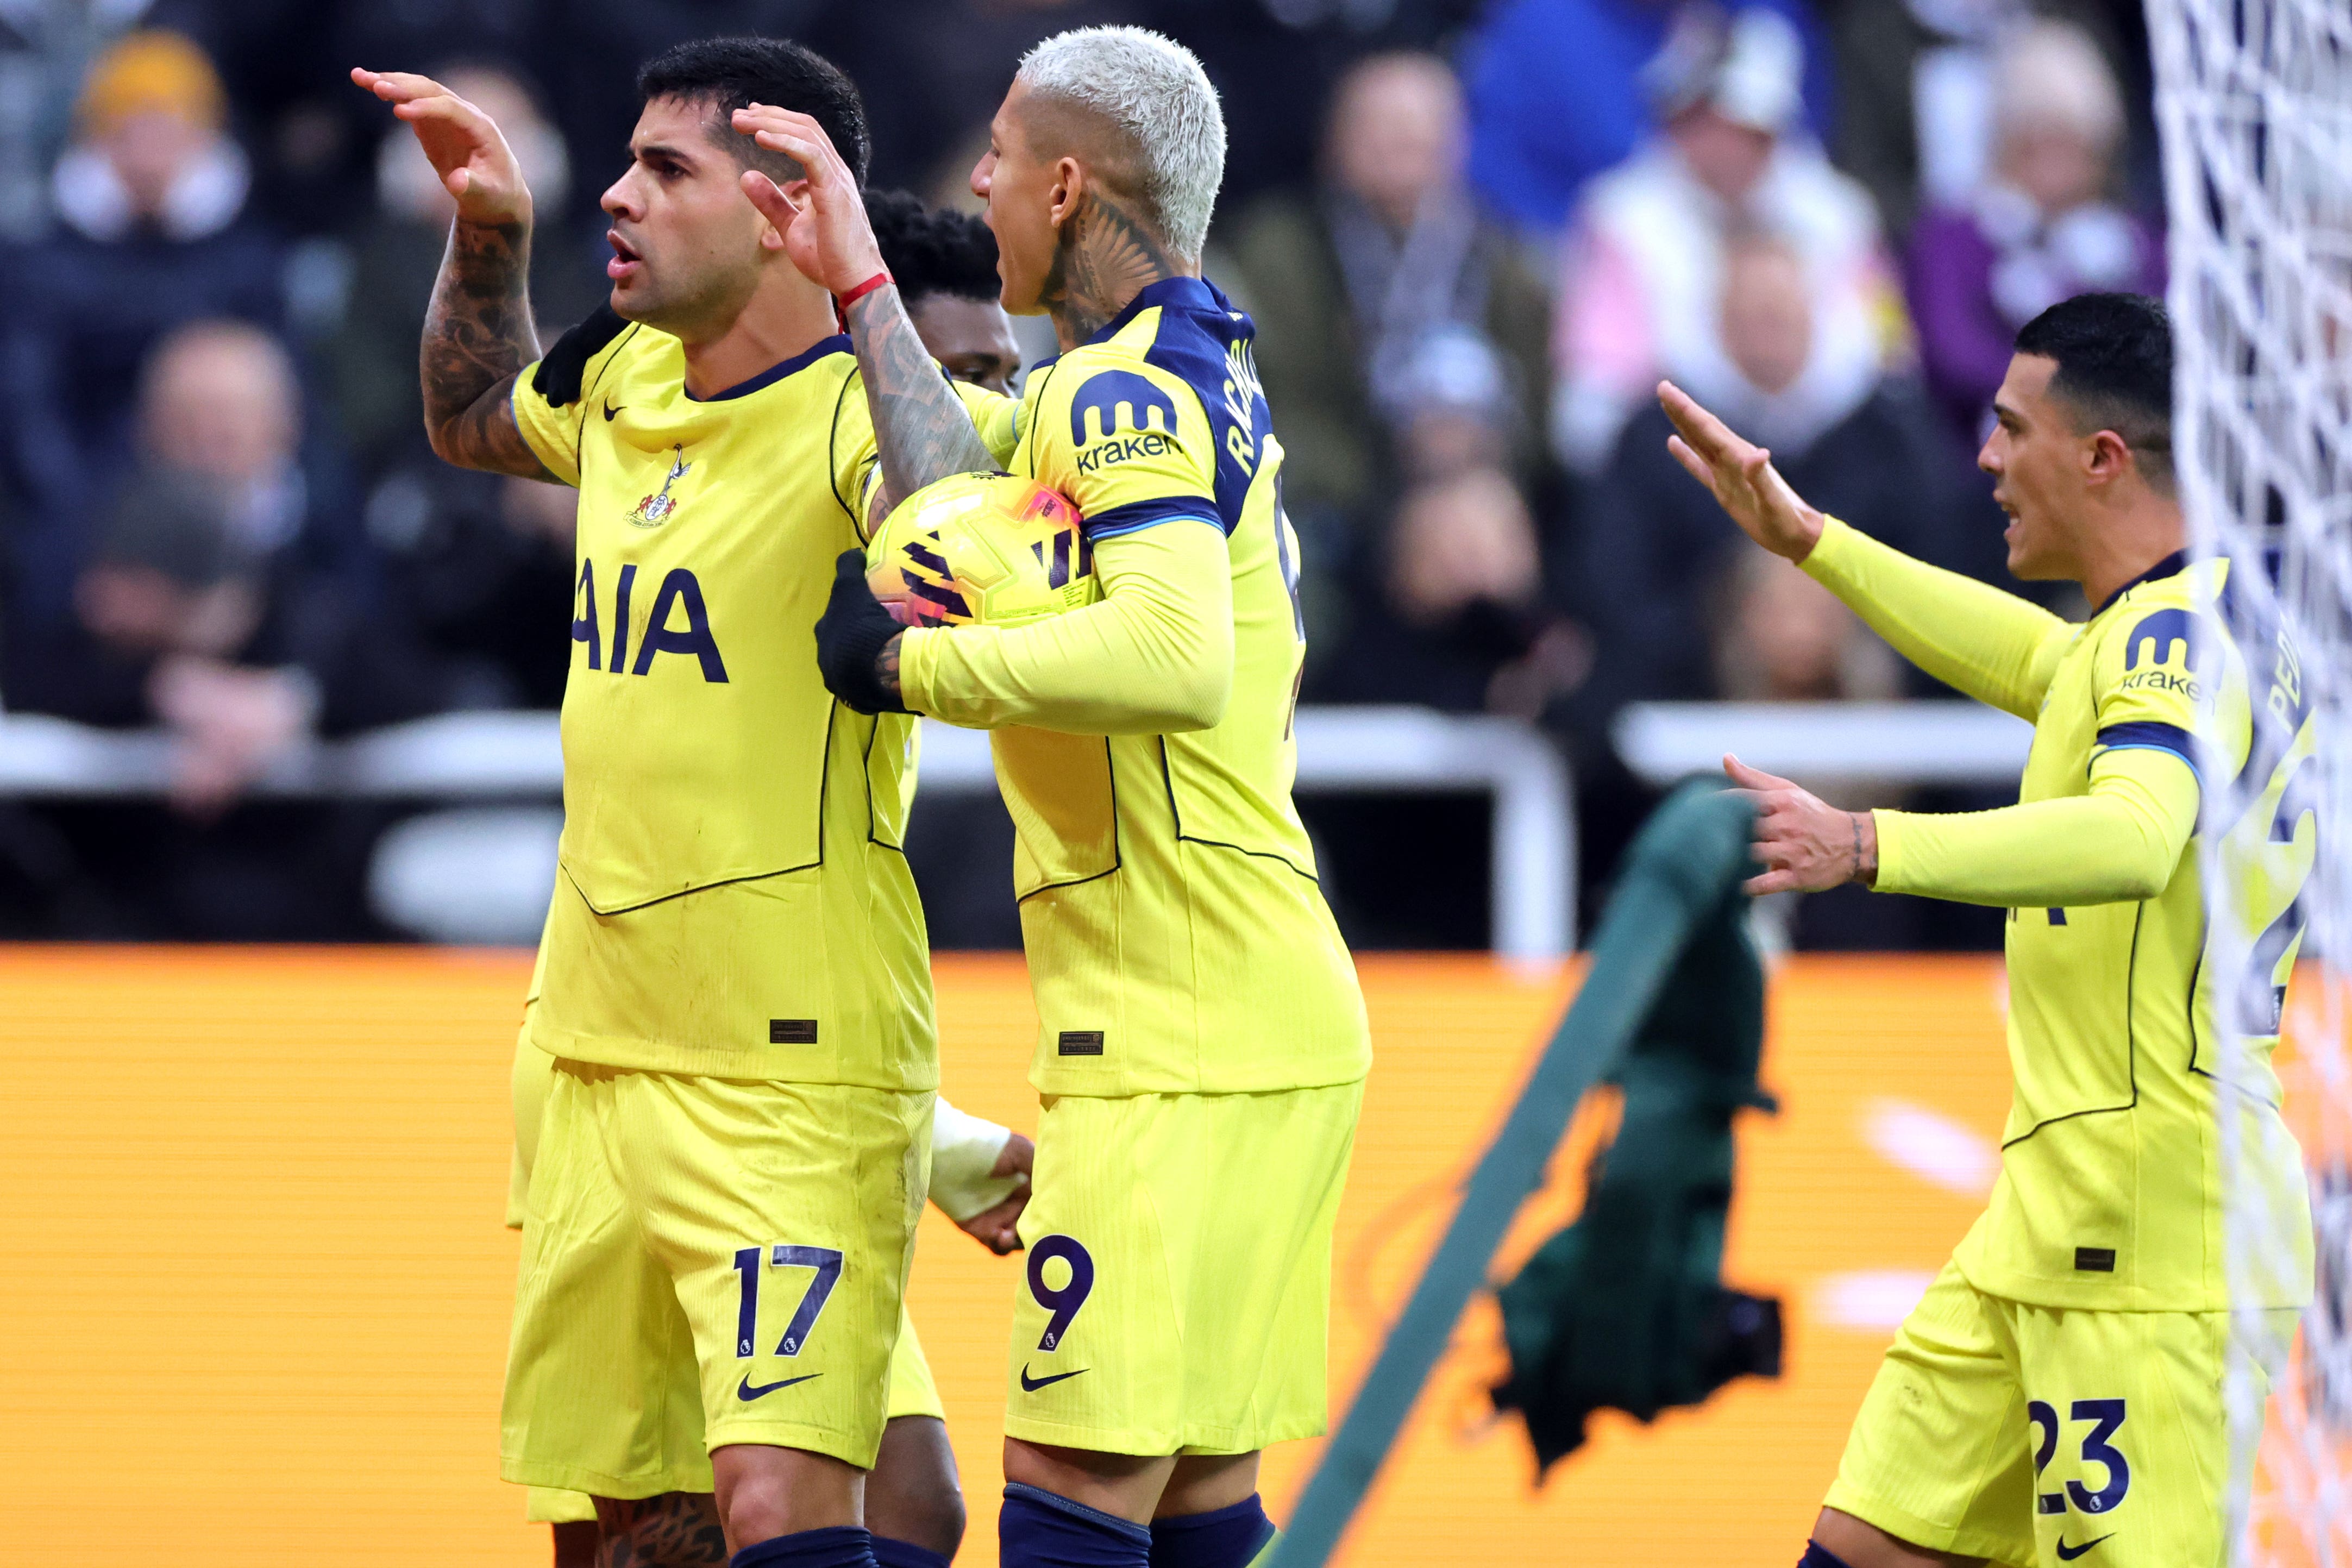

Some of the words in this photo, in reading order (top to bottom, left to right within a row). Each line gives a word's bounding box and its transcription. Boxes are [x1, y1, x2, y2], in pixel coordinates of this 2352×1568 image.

[572, 557, 730, 683] AIA
[2120, 672, 2216, 716] krake
[733, 1244, 845, 1358] 17
[1026, 1234, 1094, 1352] 9
[2027, 1397, 2130, 1515] 23
